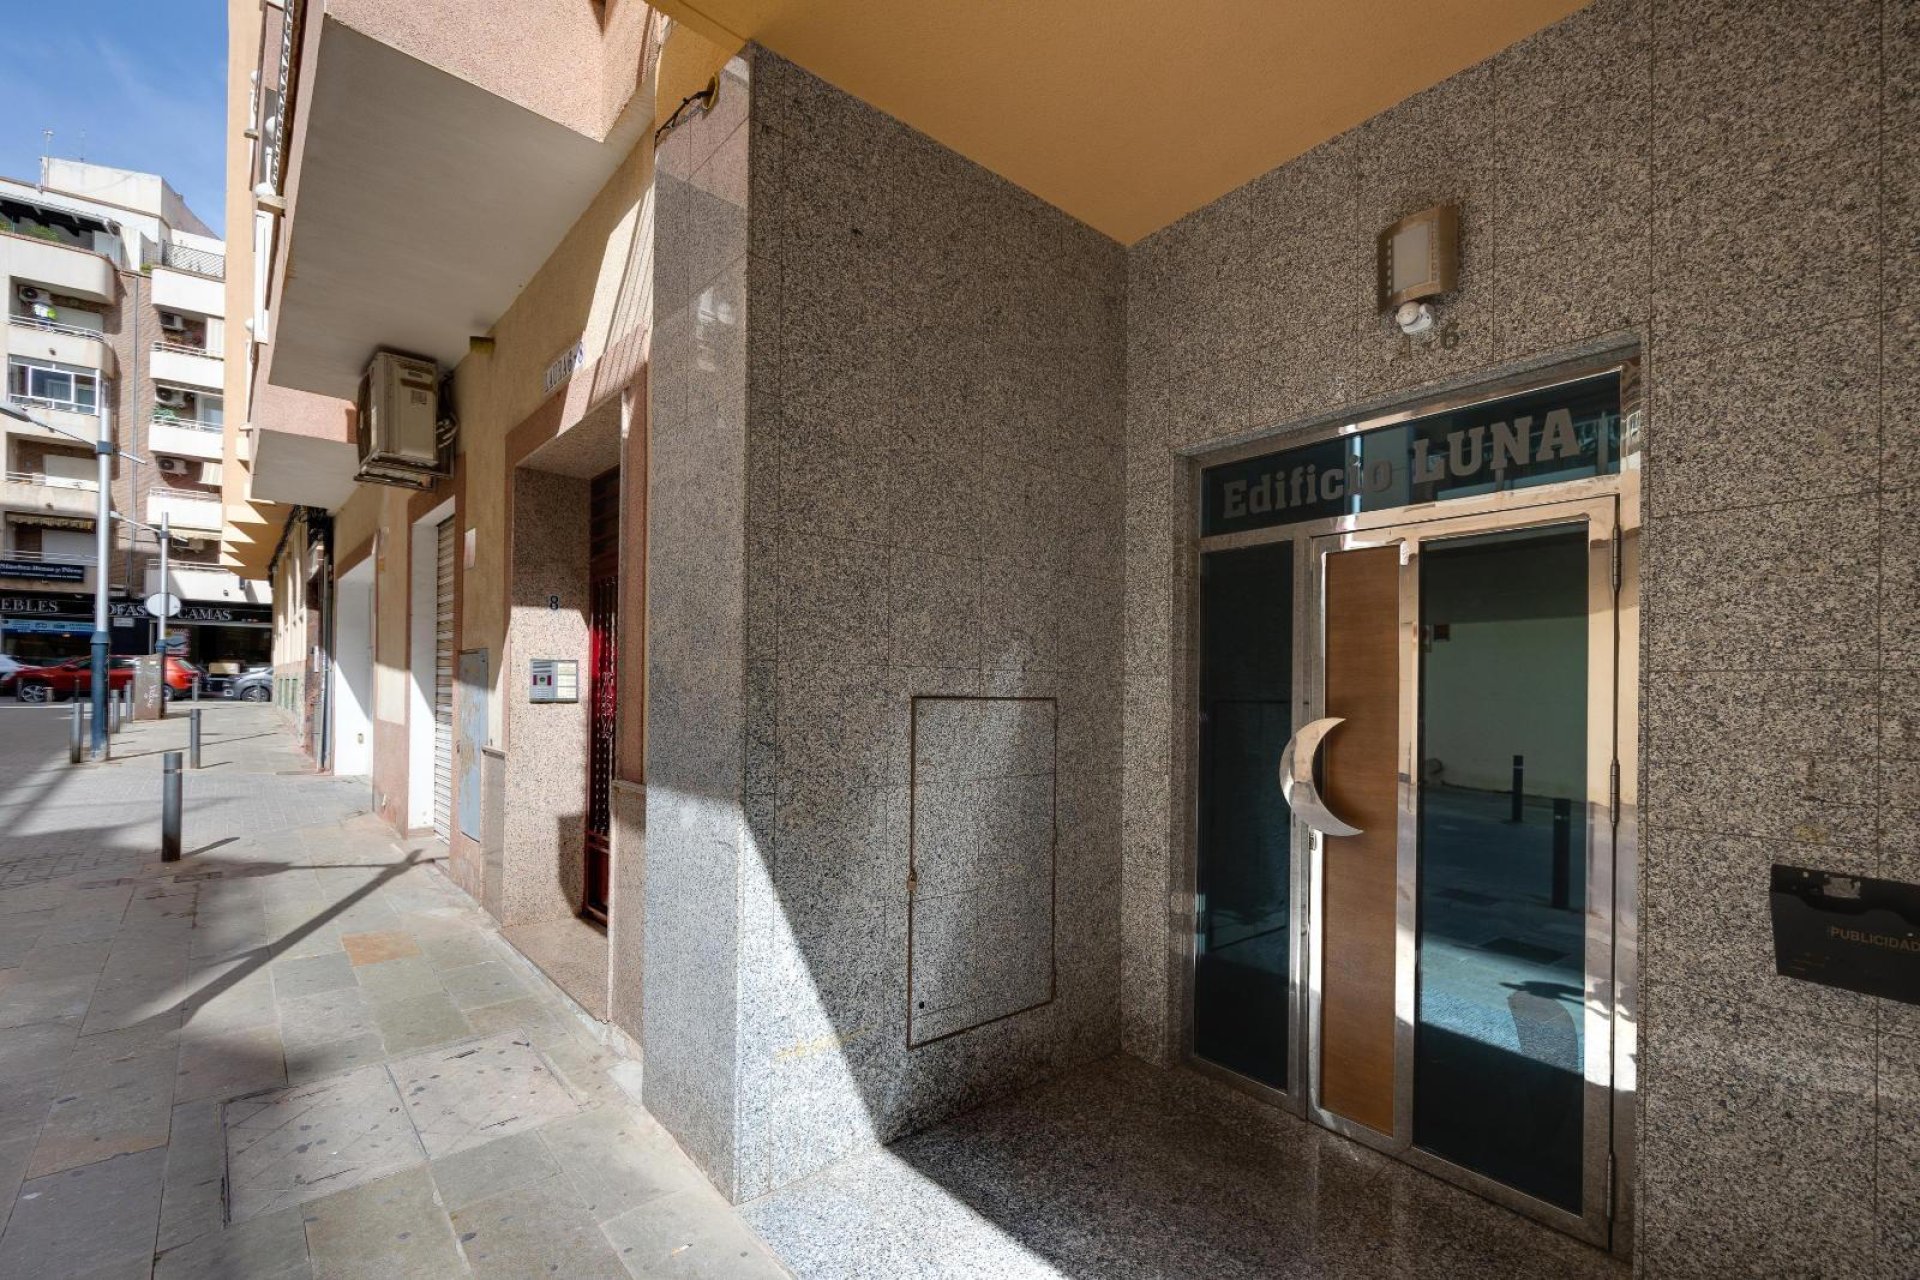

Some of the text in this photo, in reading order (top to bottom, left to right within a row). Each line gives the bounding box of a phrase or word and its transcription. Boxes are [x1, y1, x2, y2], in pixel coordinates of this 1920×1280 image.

[1440, 321, 1460, 350] 6
[1223, 408, 1581, 519] Edificio LUNA
[92, 602, 147, 616] OFAS
[178, 607, 232, 621] CAMAS
[550, 595, 559, 610] 8
[1830, 926, 1920, 952] PUBLICIDAD
